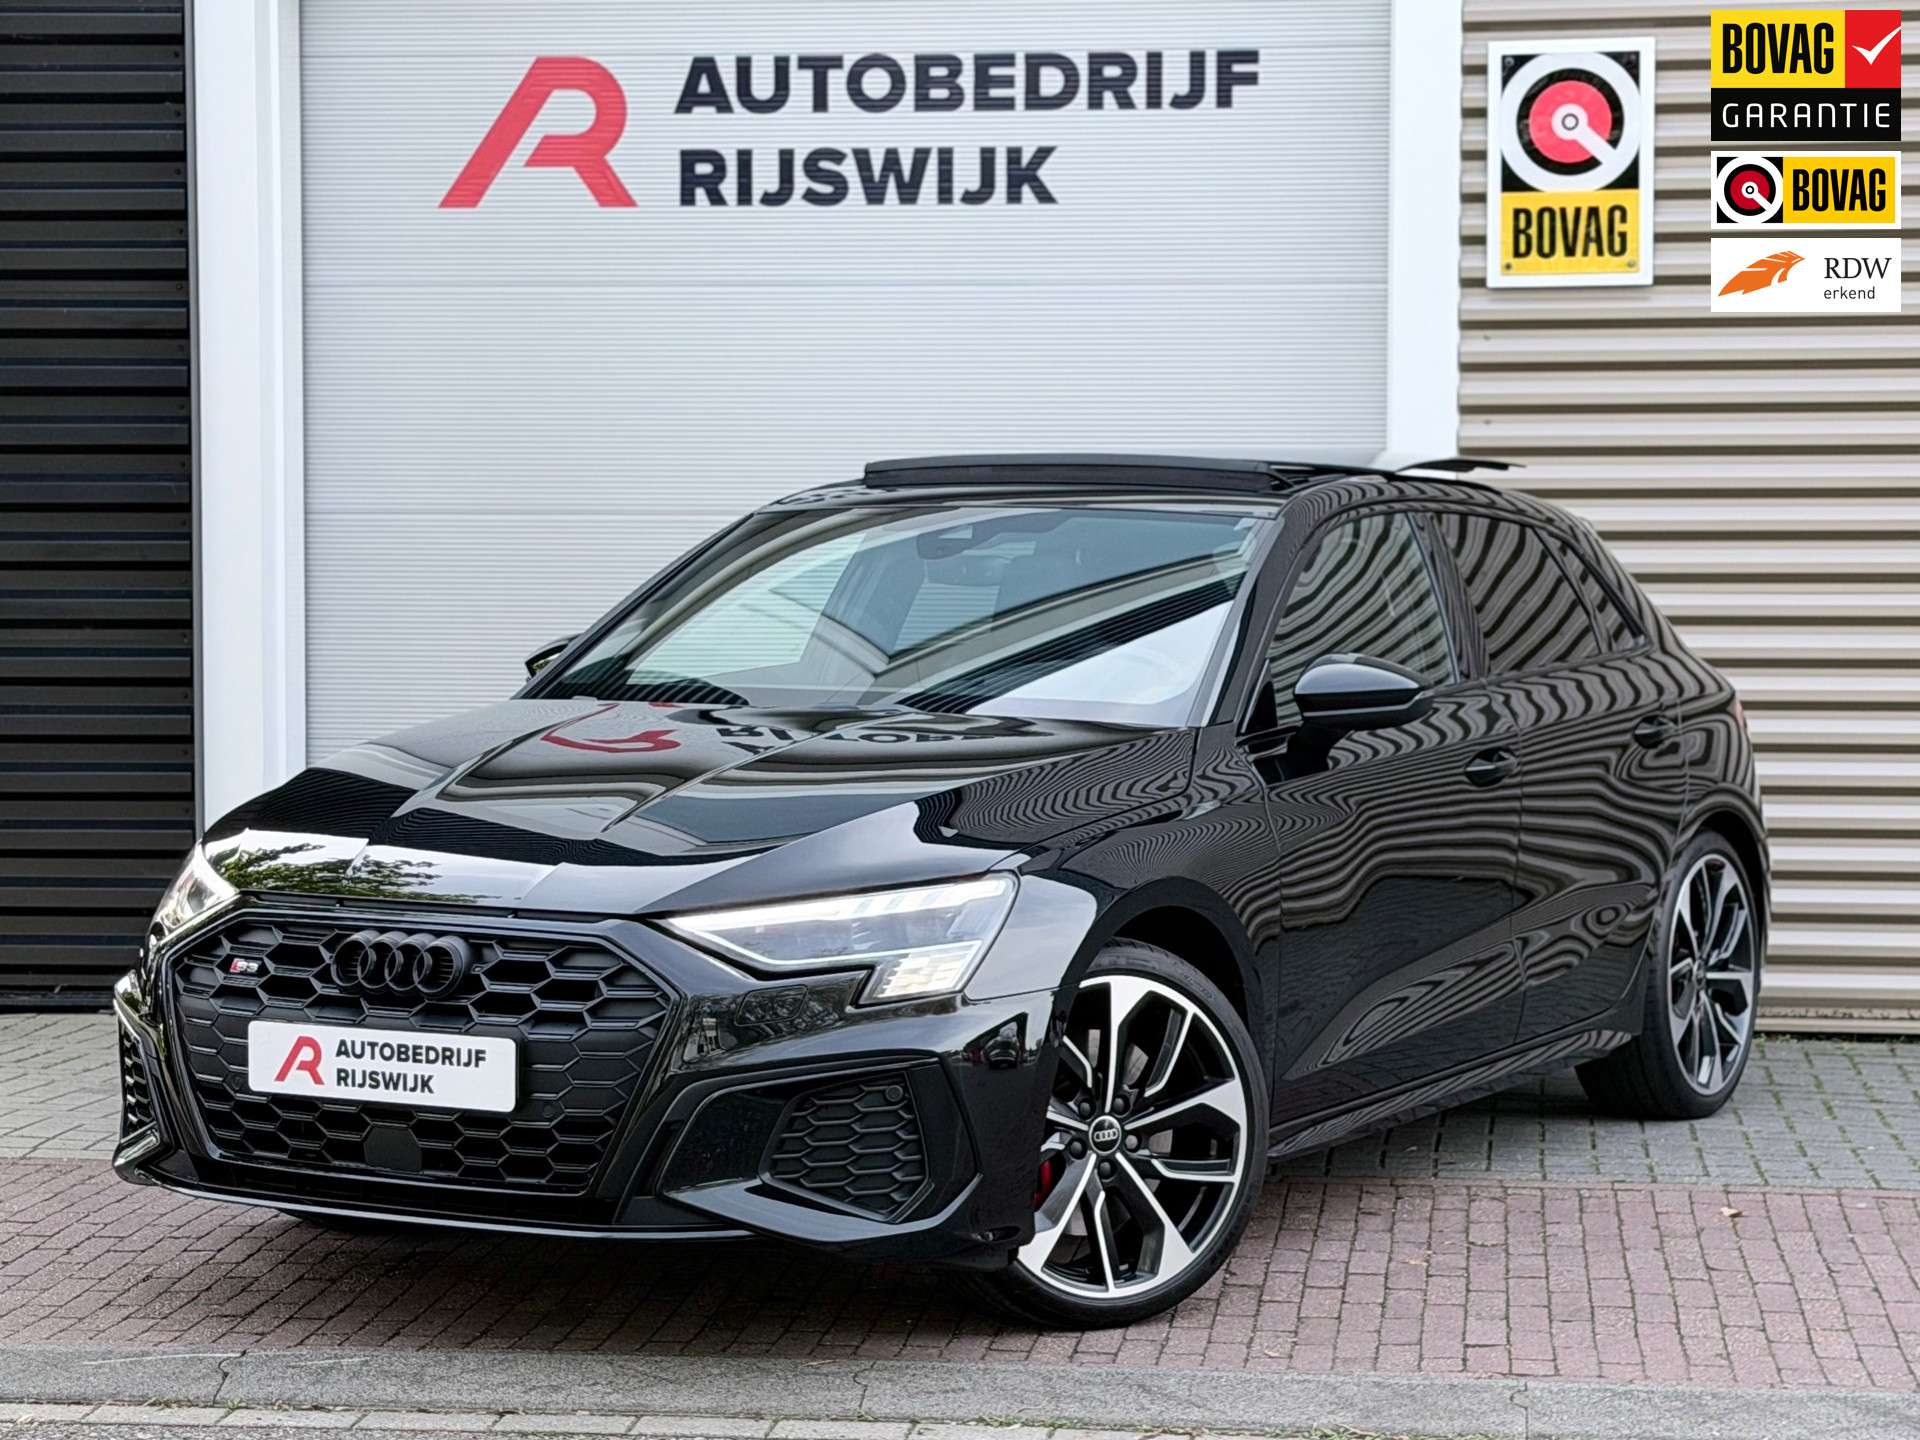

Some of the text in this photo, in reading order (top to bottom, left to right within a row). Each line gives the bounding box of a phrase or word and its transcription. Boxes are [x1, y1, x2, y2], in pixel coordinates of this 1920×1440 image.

[675, 50, 1260, 114] AUTOBEDRIJF
[679, 147, 1058, 206] RIJSWIJK
[1513, 205, 1628, 259] BOVAG
[335, 1039, 487, 1068] AUTOBEDRIJF
[336, 1068, 435, 1095] RIJSWIJK
